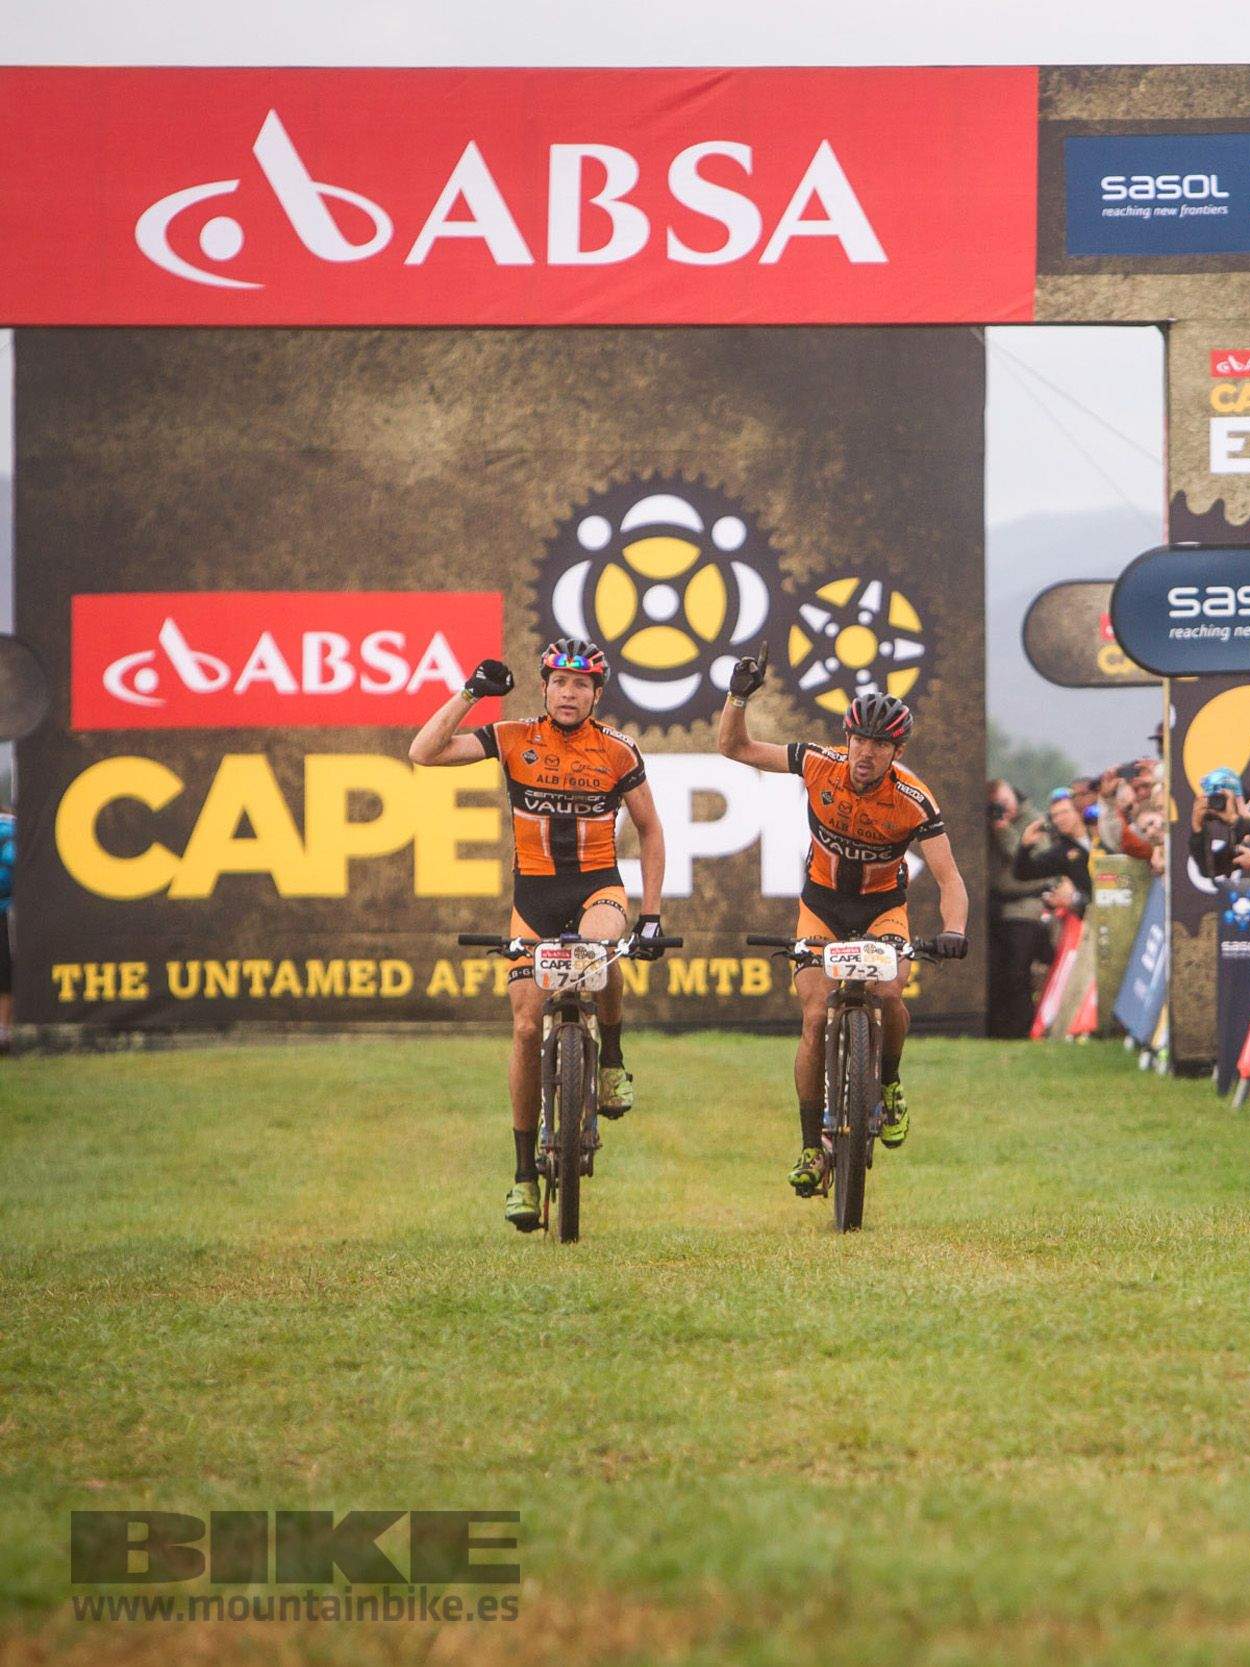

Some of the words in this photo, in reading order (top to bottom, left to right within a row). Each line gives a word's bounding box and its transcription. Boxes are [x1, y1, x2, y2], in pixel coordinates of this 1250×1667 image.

[404, 138, 889, 267] ABSA
[1102, 206, 1150, 218] reaching
[1154, 207, 1177, 216] new
[1179, 204, 1229, 217] frontiers
[1169, 624, 1230, 641] reaching
[234, 630, 467, 695] ABSA
[54, 752, 501, 901] CAPE
[540, 960, 572, 970] CAPE
[830, 955, 861, 963] CAPE
[52, 961, 150, 1002] THE
[166, 958, 414, 999] UNTAMED
[668, 957, 773, 997] MTB
[845, 965, 878, 978] 7-2
